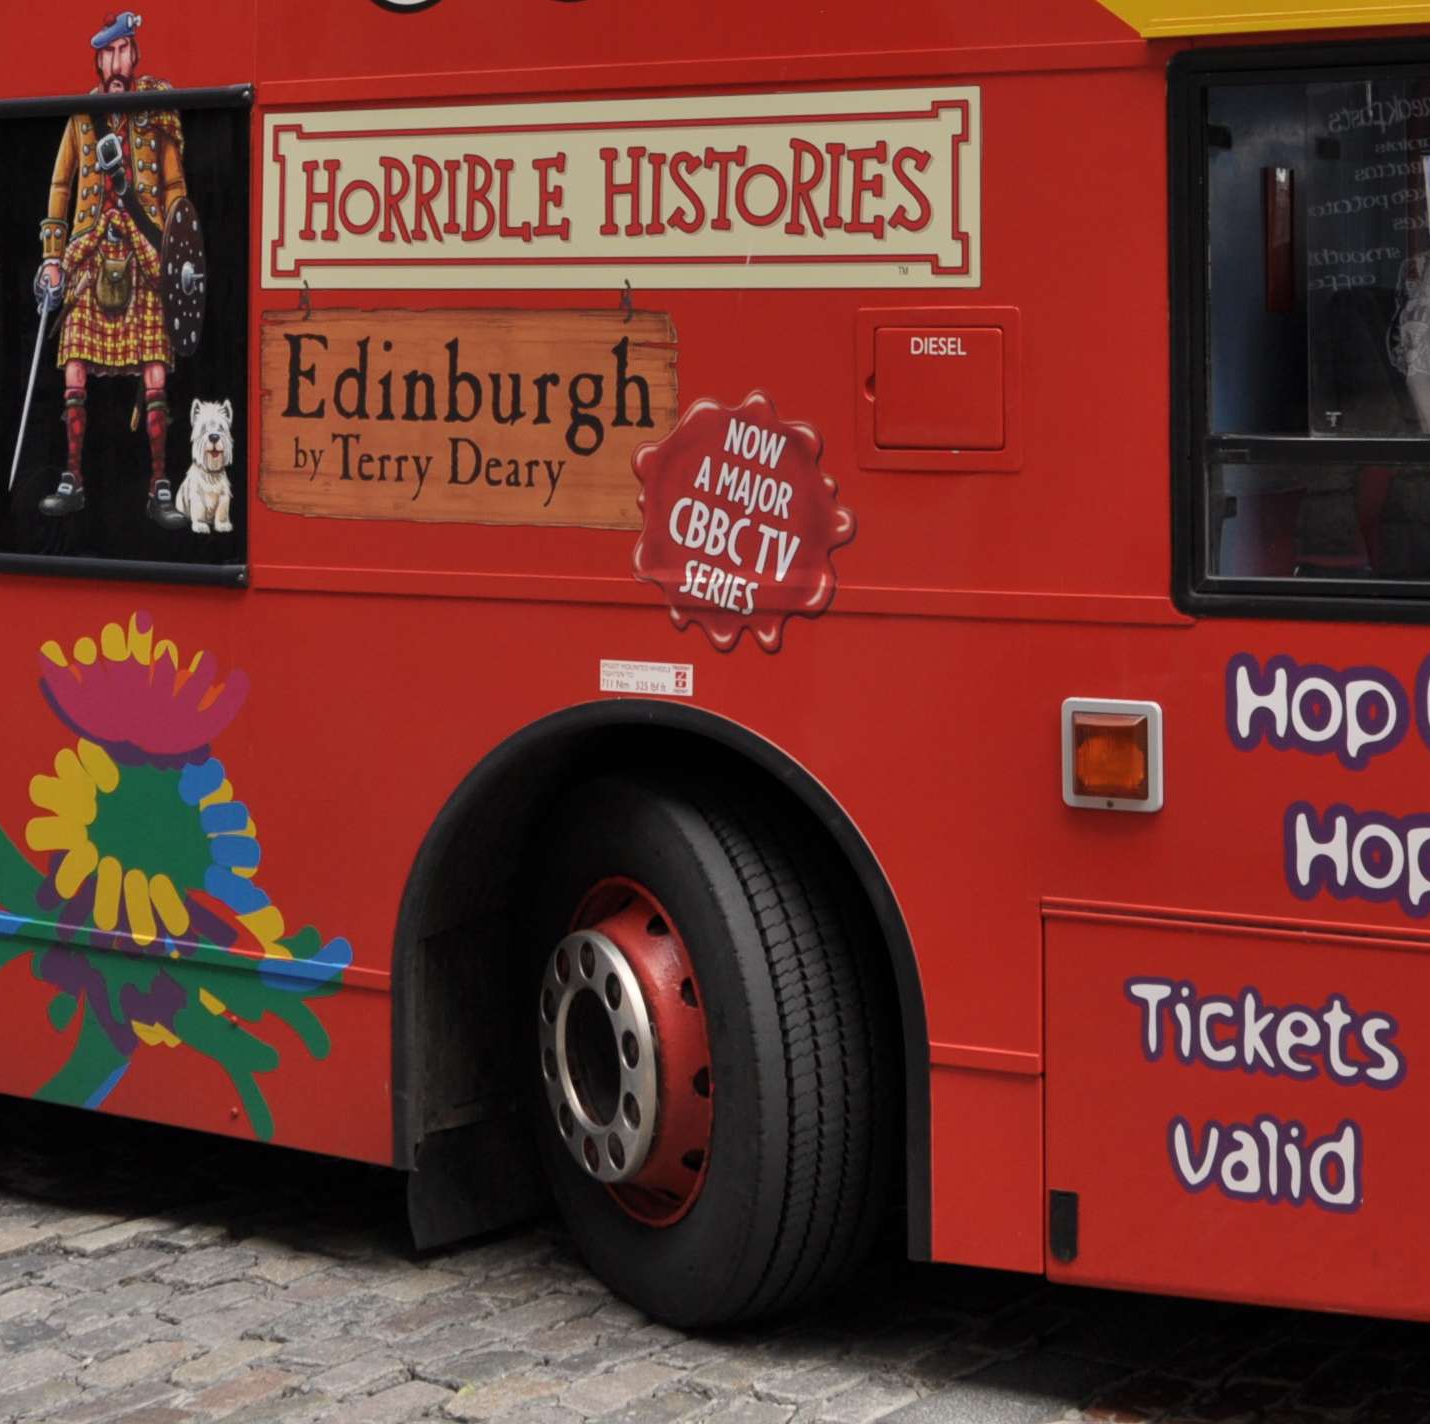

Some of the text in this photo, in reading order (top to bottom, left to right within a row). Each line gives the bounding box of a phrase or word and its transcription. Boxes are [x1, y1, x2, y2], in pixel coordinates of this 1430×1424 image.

[297, 135, 934, 245] HORRIBLE HISTORIES
[908, 335, 968, 358] DIESEL
[280, 331, 656, 457] Edinburgh
[293, 431, 567, 506] by Terry Deary
[722, 418, 787, 471] NOW
[694, 456, 794, 520] A MAJOR
[668, 496, 802, 583] CBBC TV
[679, 559, 760, 618] SERIES
[1233, 661, 1399, 760] Hop
[1130, 982, 1402, 1083] Tickets
[1170, 1120, 1360, 1206] valid
